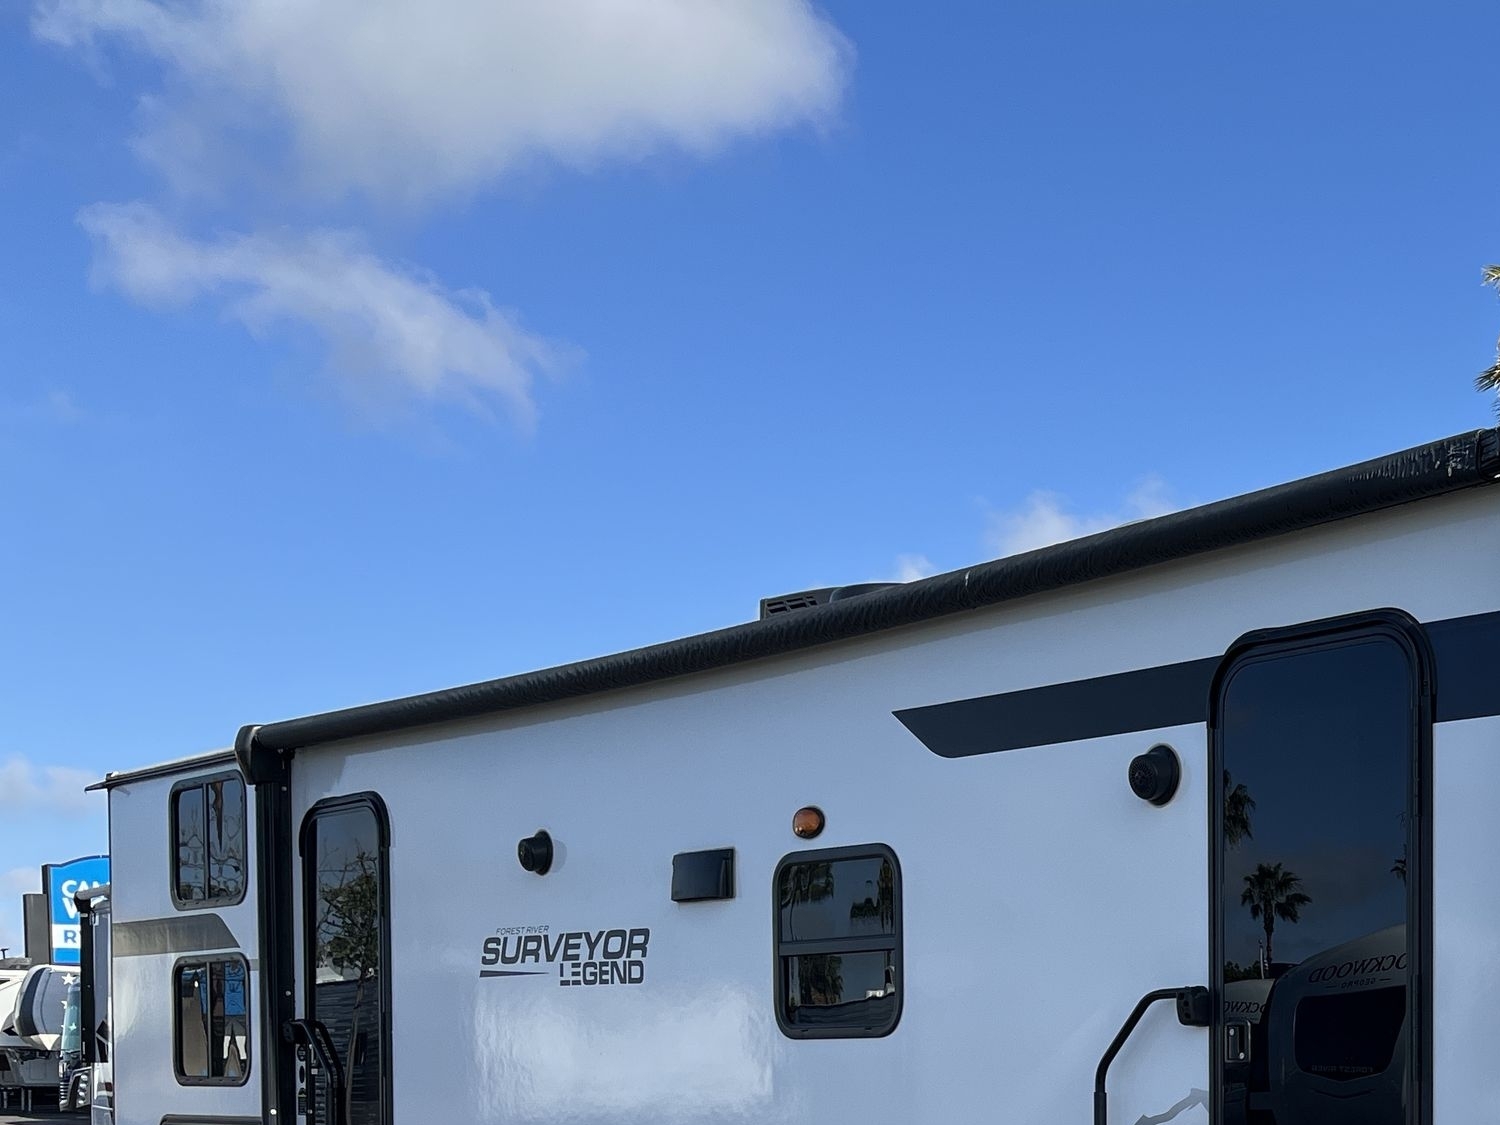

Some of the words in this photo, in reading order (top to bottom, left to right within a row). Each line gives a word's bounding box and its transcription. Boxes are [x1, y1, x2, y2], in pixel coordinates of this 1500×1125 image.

[495, 926, 526, 936] FOREST
[526, 925, 549, 934] RIVER
[481, 928, 650, 965] SURVEYOR
[559, 960, 644, 986] LEGEND
